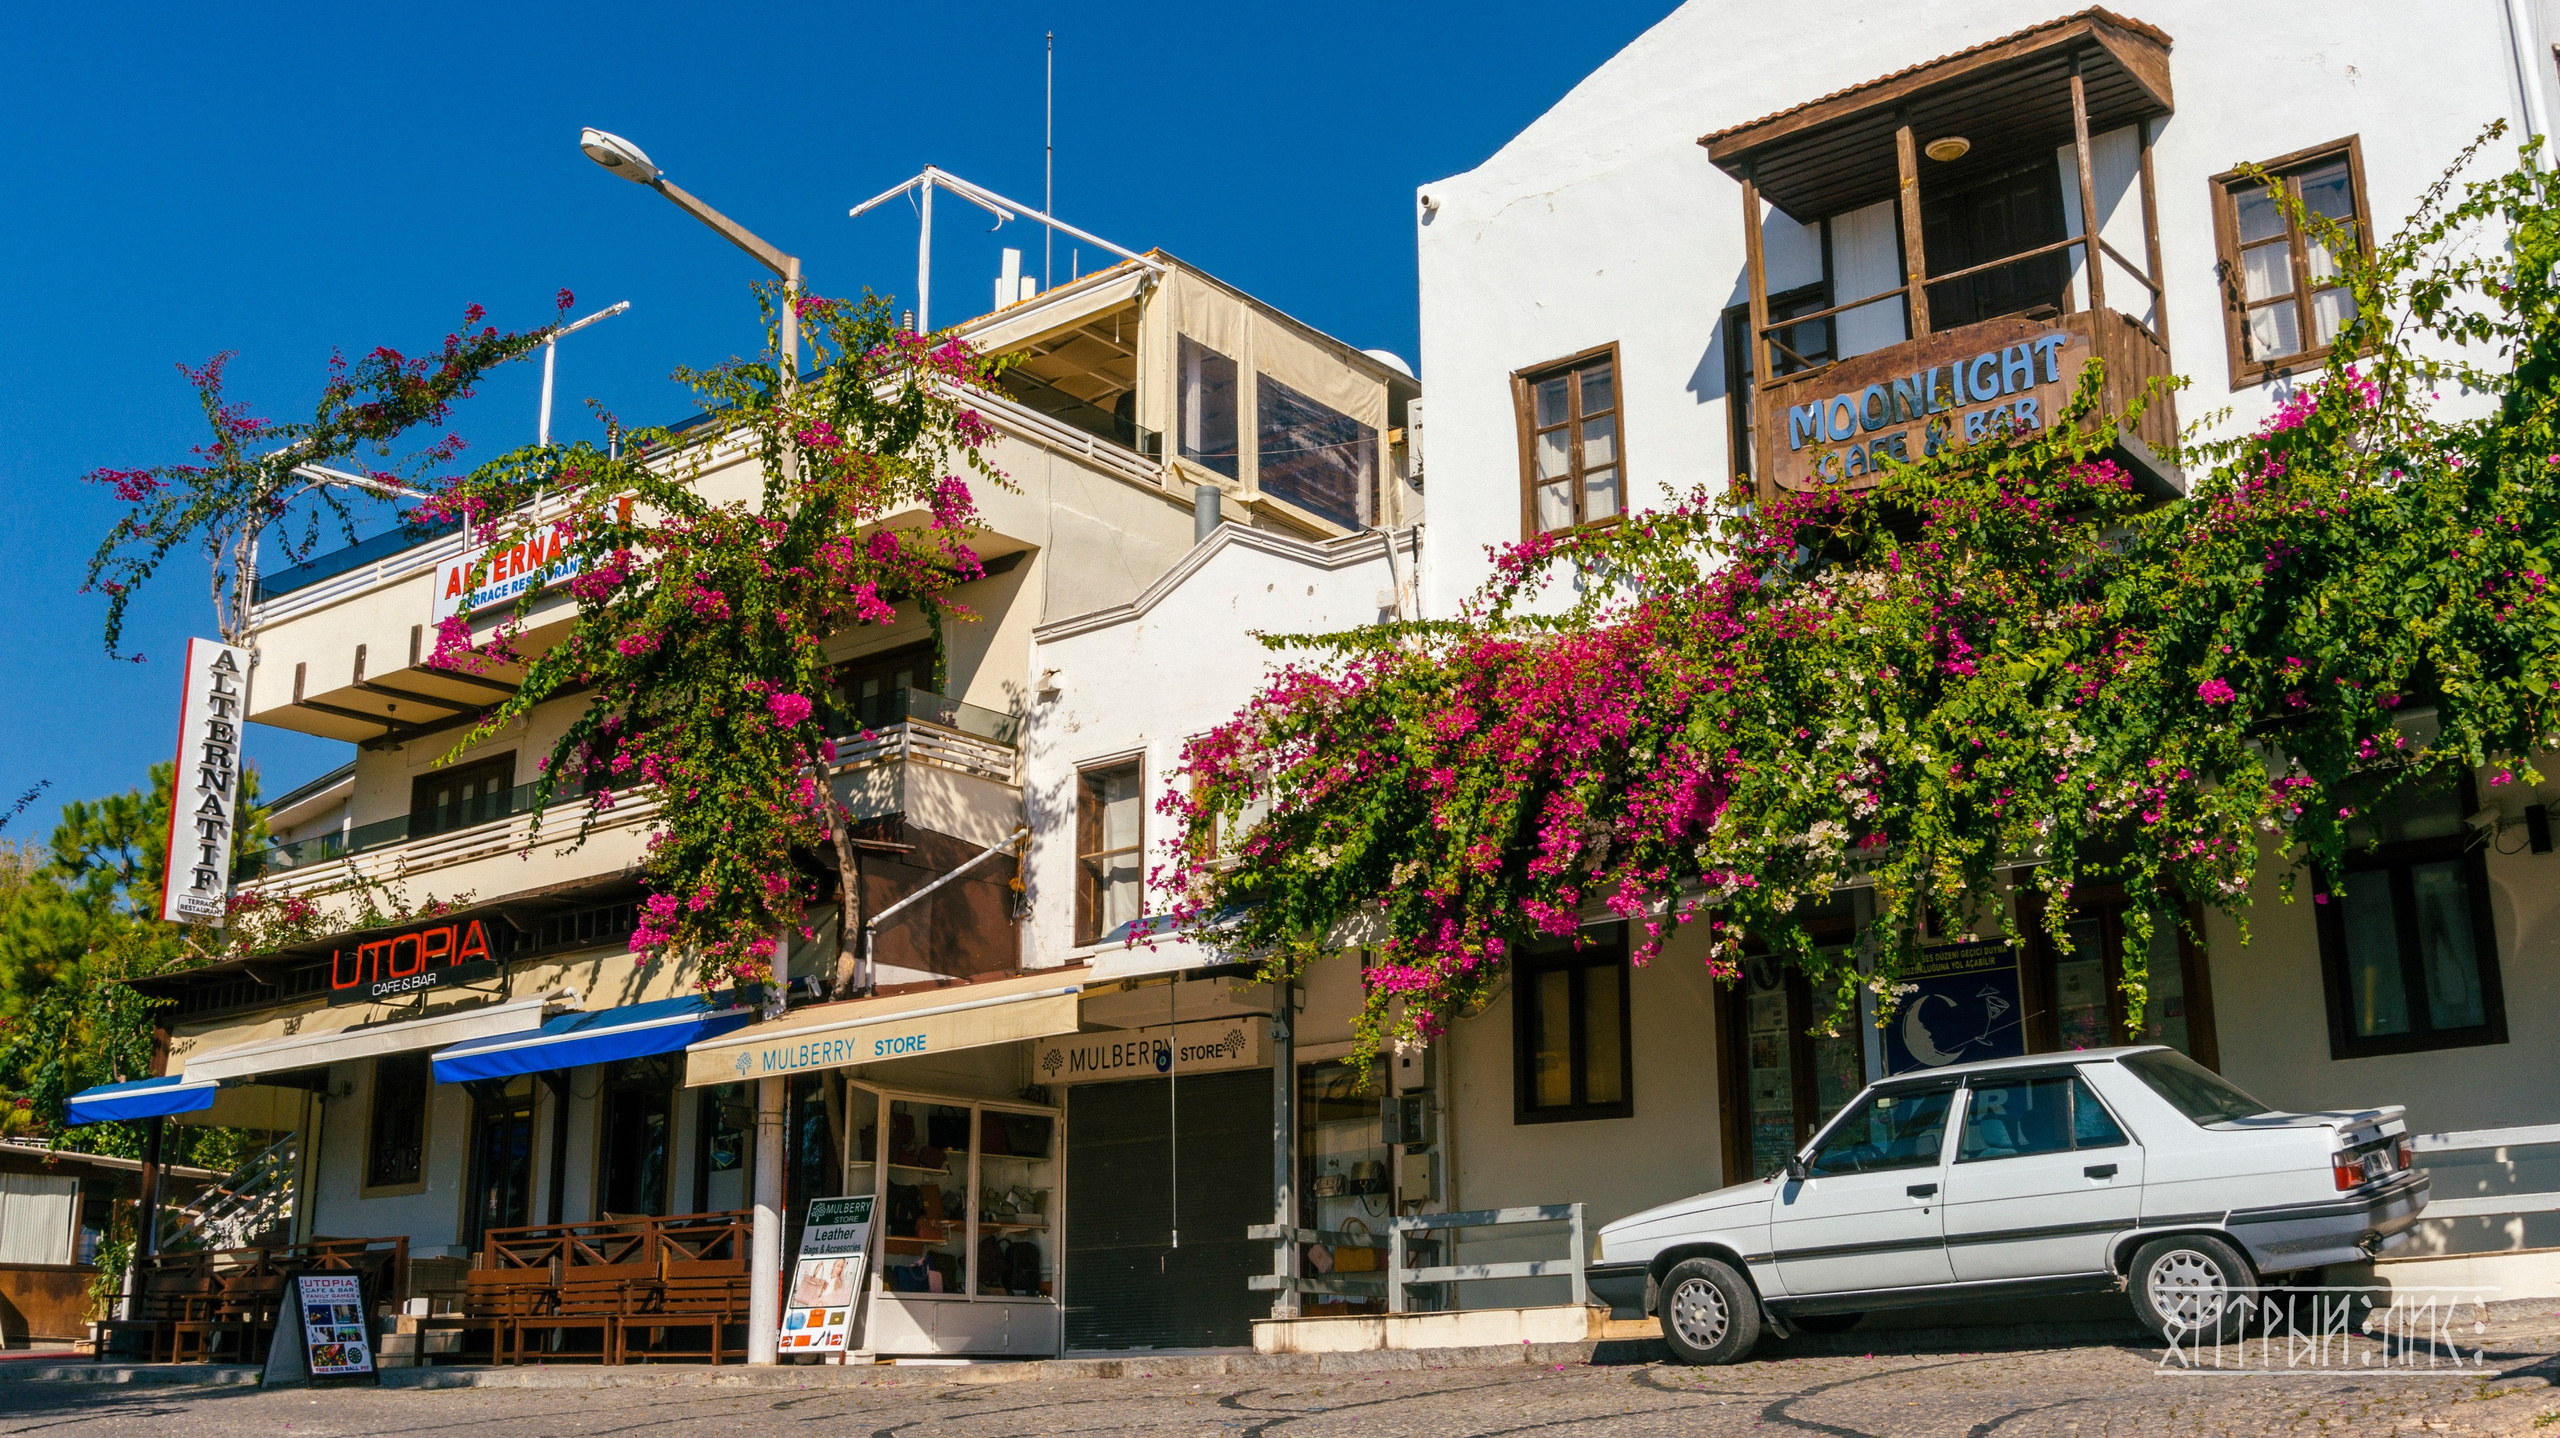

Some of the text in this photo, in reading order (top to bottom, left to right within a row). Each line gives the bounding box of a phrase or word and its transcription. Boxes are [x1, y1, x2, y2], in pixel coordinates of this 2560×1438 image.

[1789, 334, 2067, 450] MOONLIGHT
[1818, 430, 1910, 485] CAFE
[1963, 397, 2041, 446] BAR
[464, 557, 584, 609] RRACE RESAURANT
[190, 649, 240, 891] ALTERNATIF
[332, 919, 491, 991] UTOPIA
[371, 979, 401, 996] CAFE
[411, 972, 437, 988] BAR
[762, 1034, 927, 1073] MULBERRY STORE
[1180, 1043, 1224, 1062] STORE
[826, 1201, 872, 1214] MULBERRY
[833, 1215, 859, 1224] STORE
[814, 1228, 856, 1242] Leather
[803, 1243, 861, 1257] Bags & Accessories
[304, 1279, 354, 1287] UTOPIA
